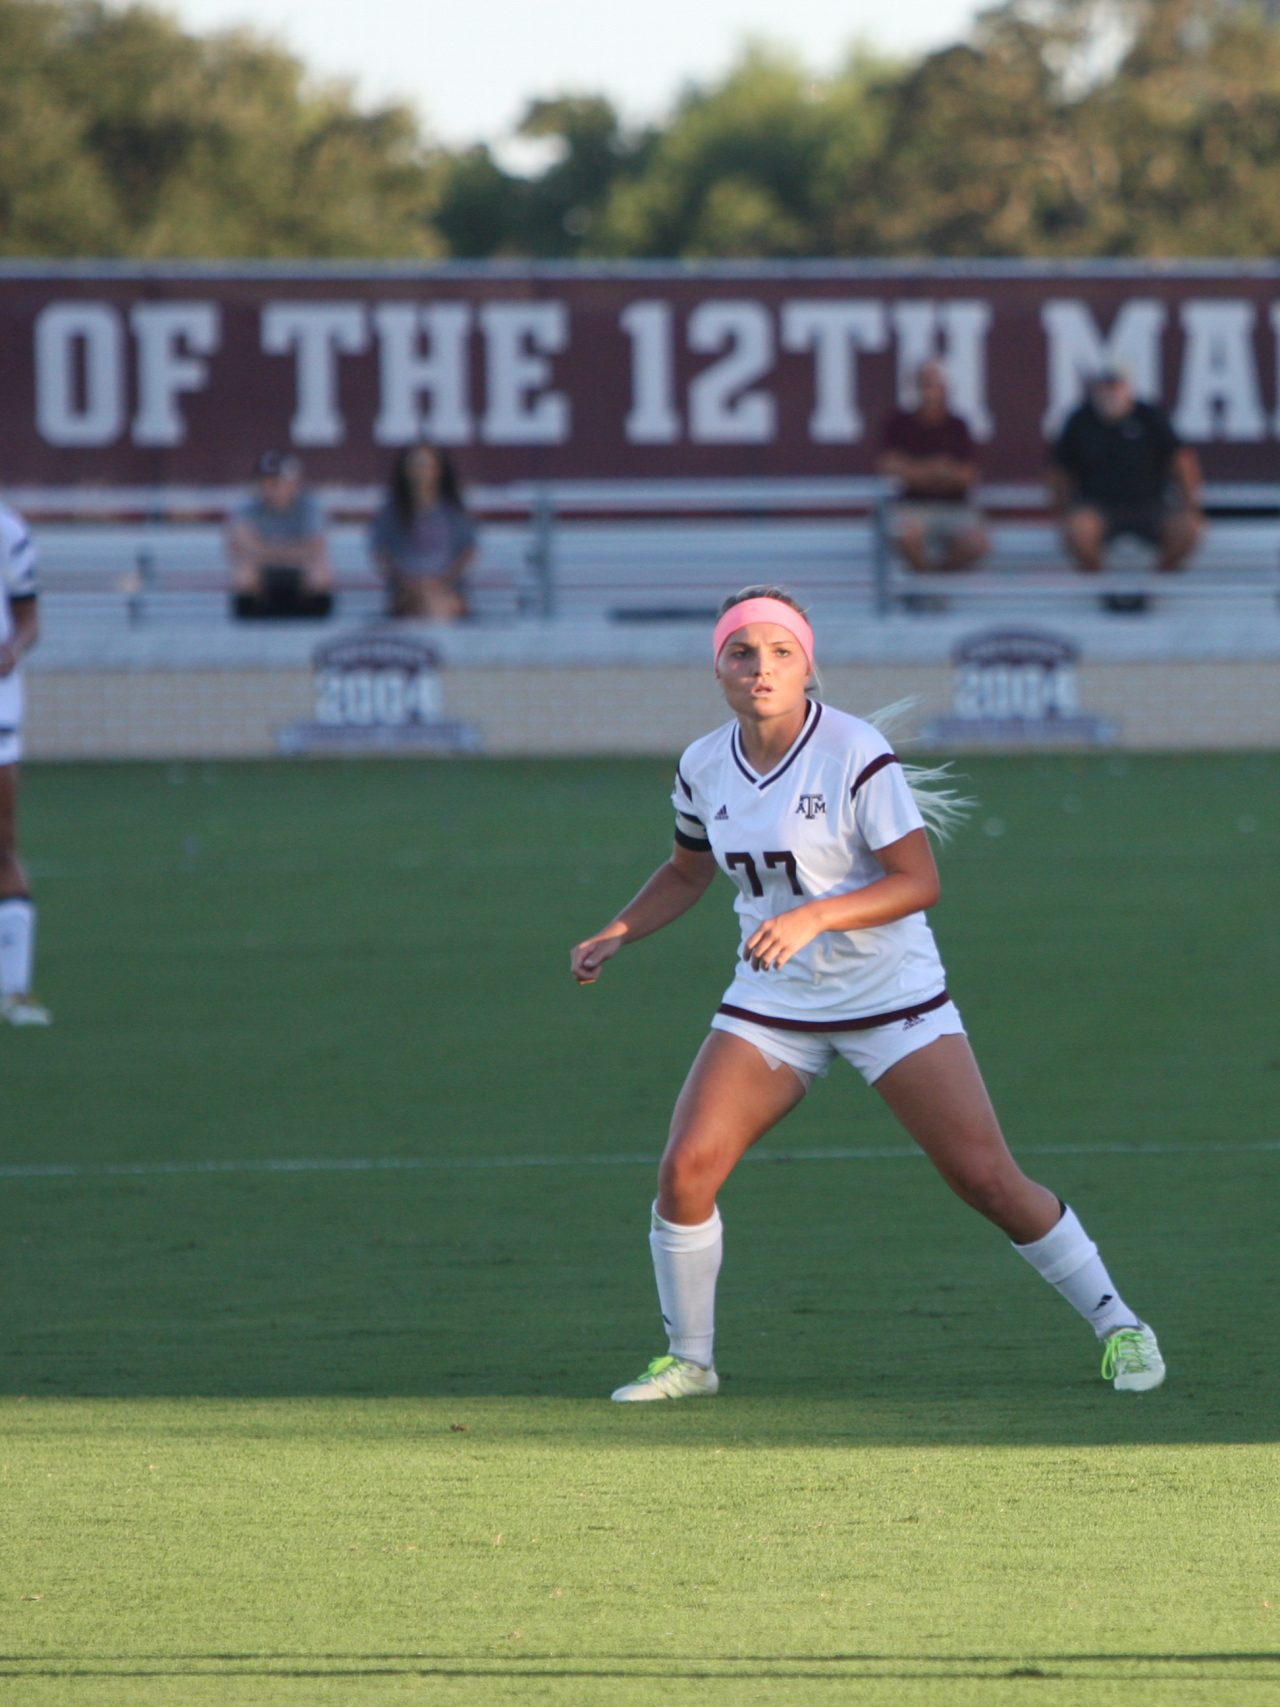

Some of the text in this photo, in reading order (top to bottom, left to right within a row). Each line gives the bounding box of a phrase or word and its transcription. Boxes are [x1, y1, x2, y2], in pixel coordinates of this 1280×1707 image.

[34, 301, 221, 446] OF
[261, 301, 568, 445] THE
[620, 301, 992, 445] 12TH
[725, 850, 804, 898] 77
